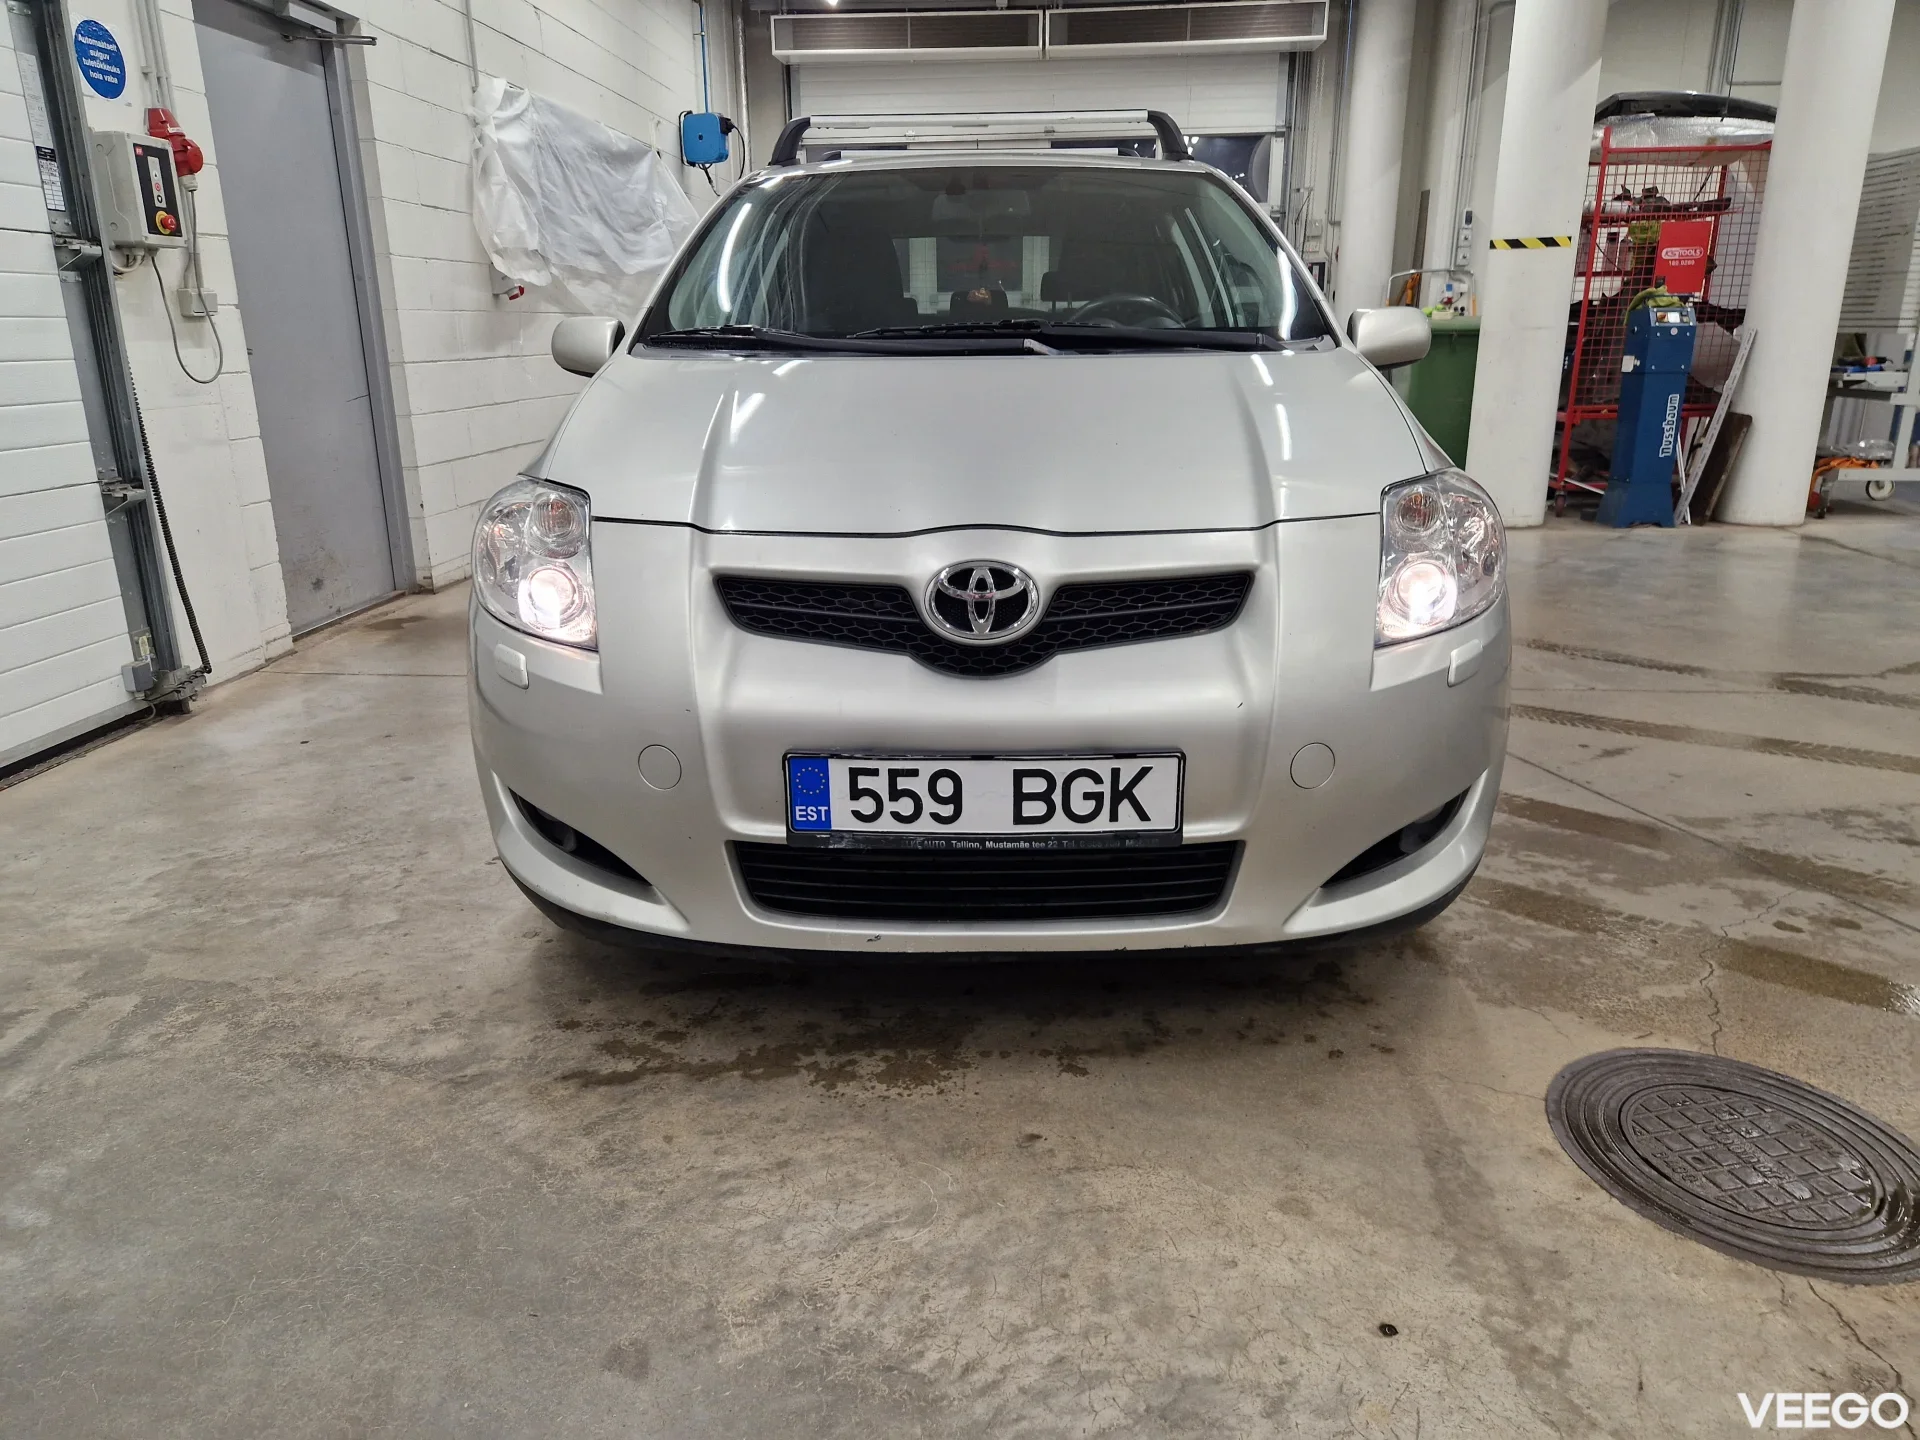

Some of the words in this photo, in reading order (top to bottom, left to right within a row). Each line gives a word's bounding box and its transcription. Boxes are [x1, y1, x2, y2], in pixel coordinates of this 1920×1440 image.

[89, 69, 104, 81] hoia
[103, 74, 119, 85] vaba
[1679, 248, 1701, 257] TOOLS
[848, 767, 963, 825] 559
[1012, 766, 1154, 825] BGK
[795, 806, 829, 822] EST
[924, 840, 946, 849] AUTO
[951, 840, 982, 850] Tallinn,
[1032, 840, 1046, 849] tee
[1047, 840, 1058, 849] 22
